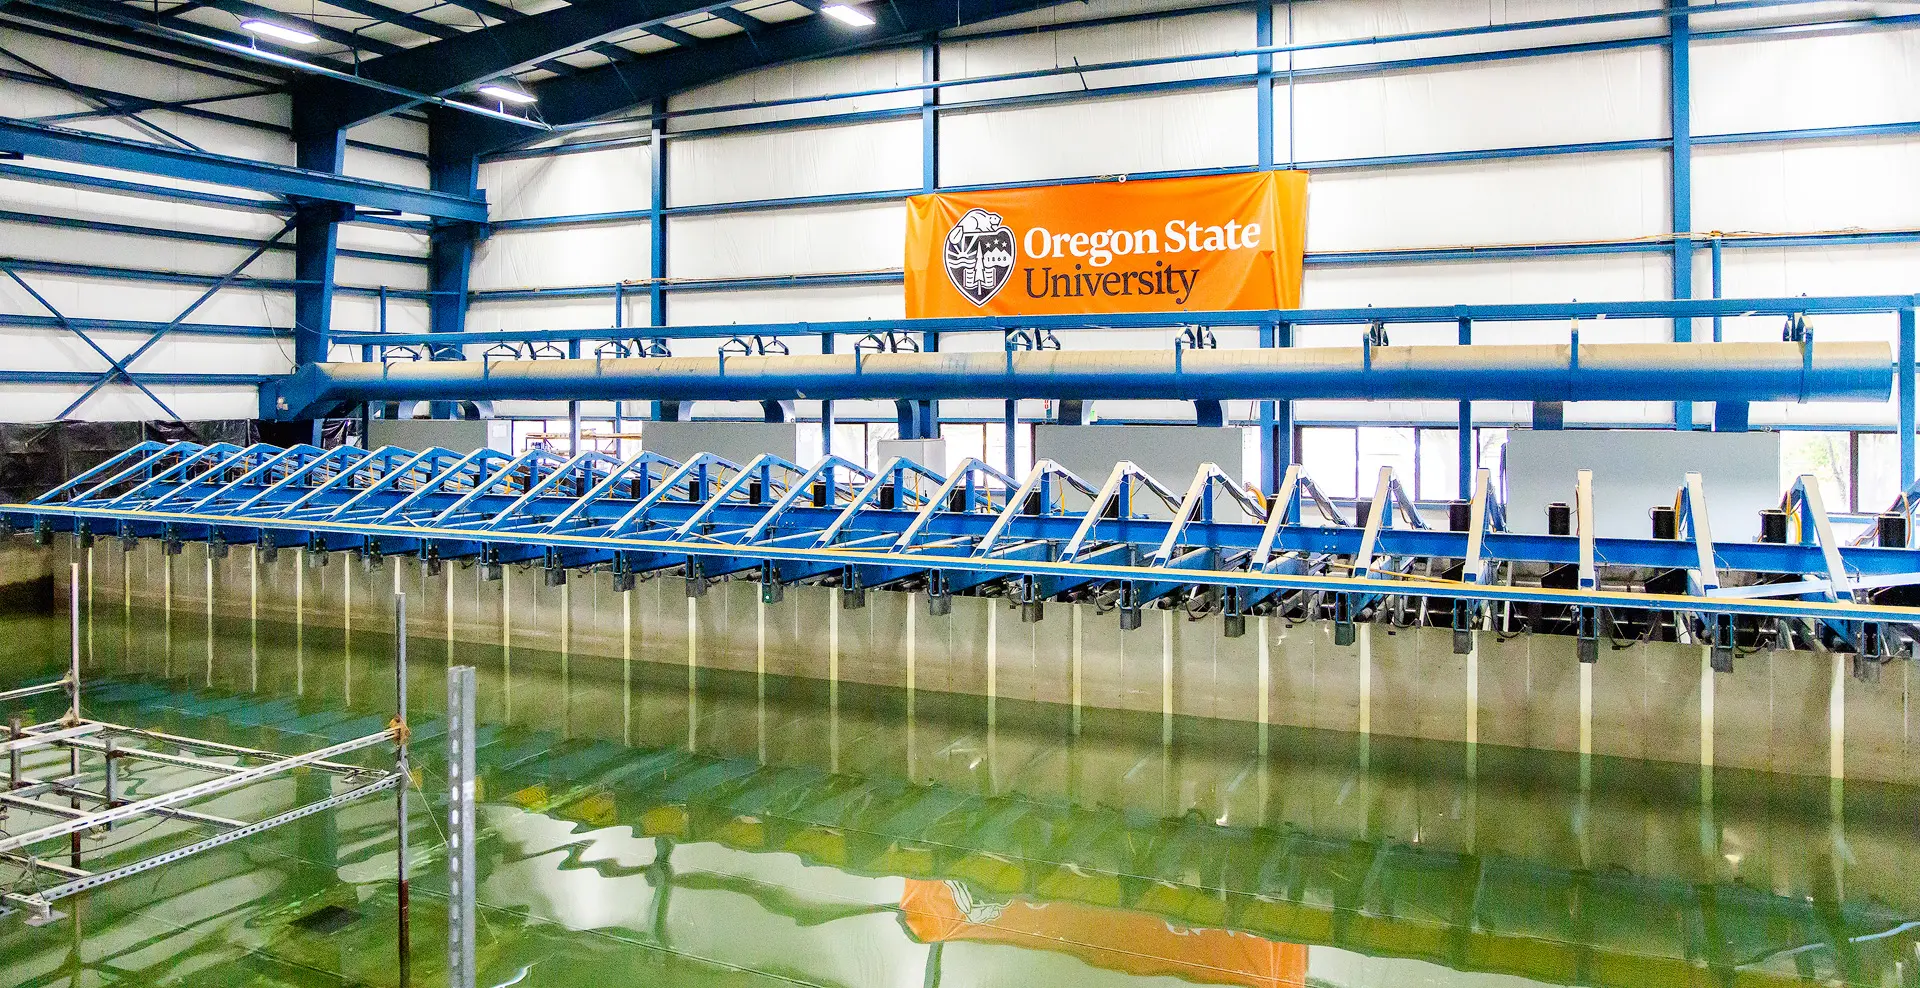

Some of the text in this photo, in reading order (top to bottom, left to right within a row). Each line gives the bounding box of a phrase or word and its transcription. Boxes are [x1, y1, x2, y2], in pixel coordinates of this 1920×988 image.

[1023, 218, 1261, 267] Oregon State
[1023, 260, 1200, 305] University
